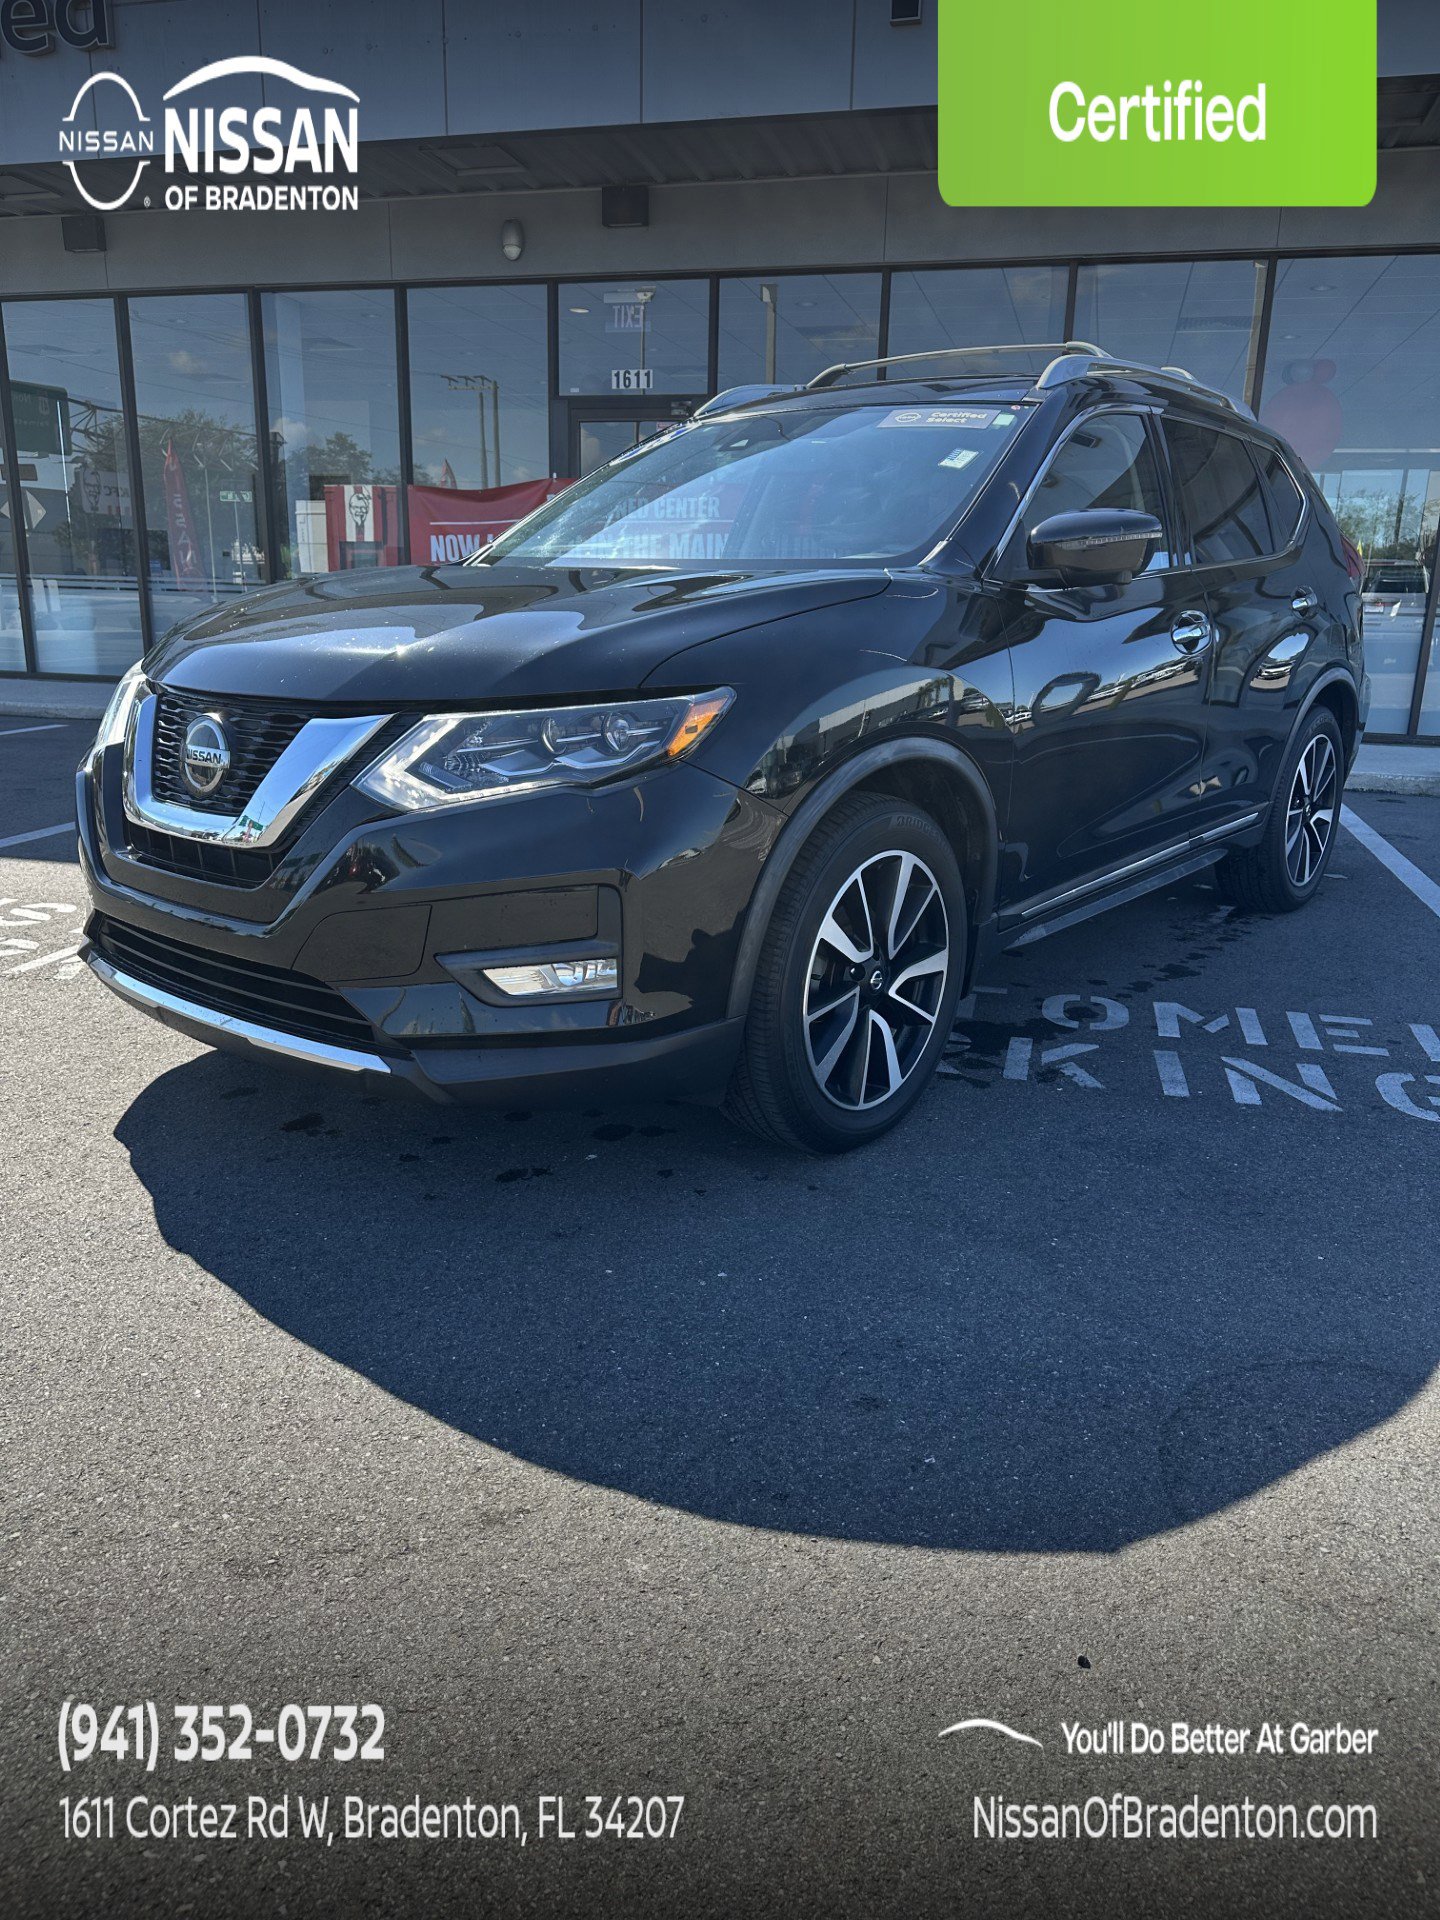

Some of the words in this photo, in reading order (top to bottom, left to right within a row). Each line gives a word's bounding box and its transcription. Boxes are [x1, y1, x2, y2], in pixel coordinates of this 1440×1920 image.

[0, 0, 109, 55] ed
[613, 369, 651, 389] 1611
[654, 497, 721, 519] CENTER
[429, 533, 480, 562] NOW
[669, 533, 730, 559] MAIN
[186, 747, 222, 764] NISSAN
